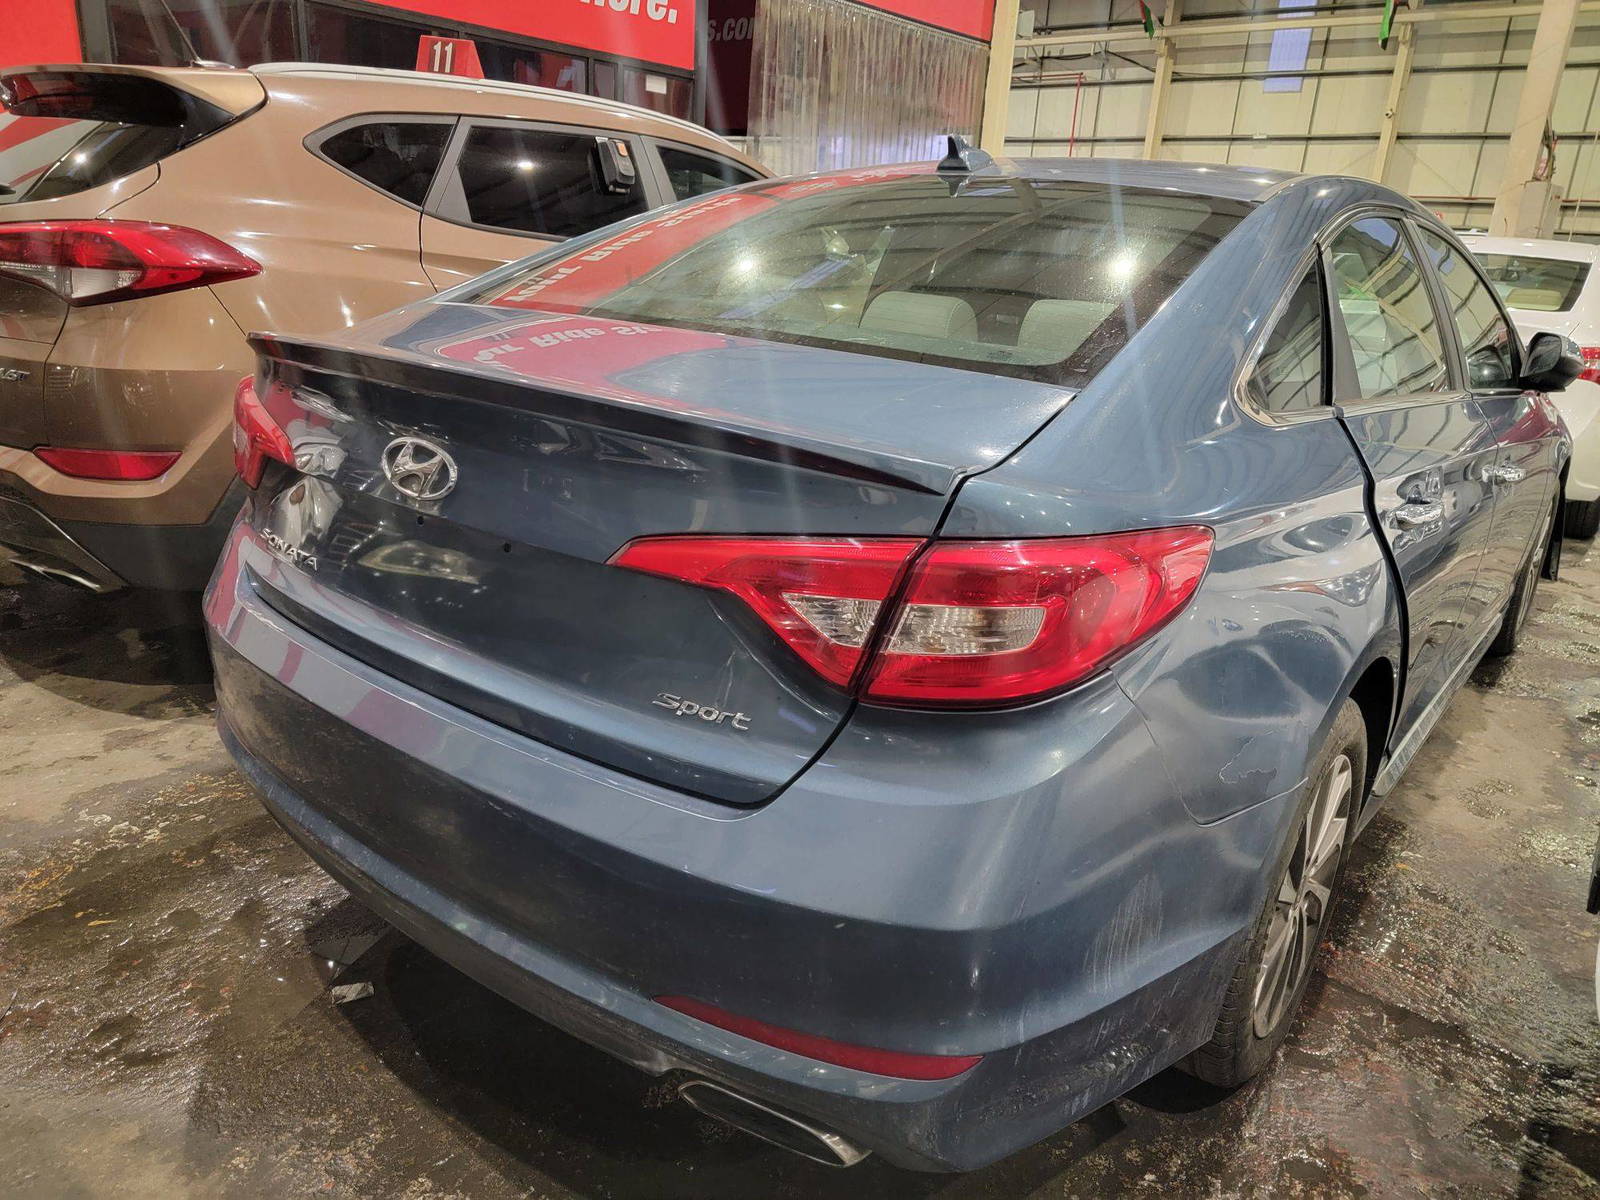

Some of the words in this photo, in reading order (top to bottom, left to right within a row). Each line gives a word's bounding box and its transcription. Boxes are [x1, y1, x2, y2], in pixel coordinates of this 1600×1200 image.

[433, 41, 453, 73] 11
[260, 528, 318, 571] SONATA
[652, 692, 752, 731] Sport
